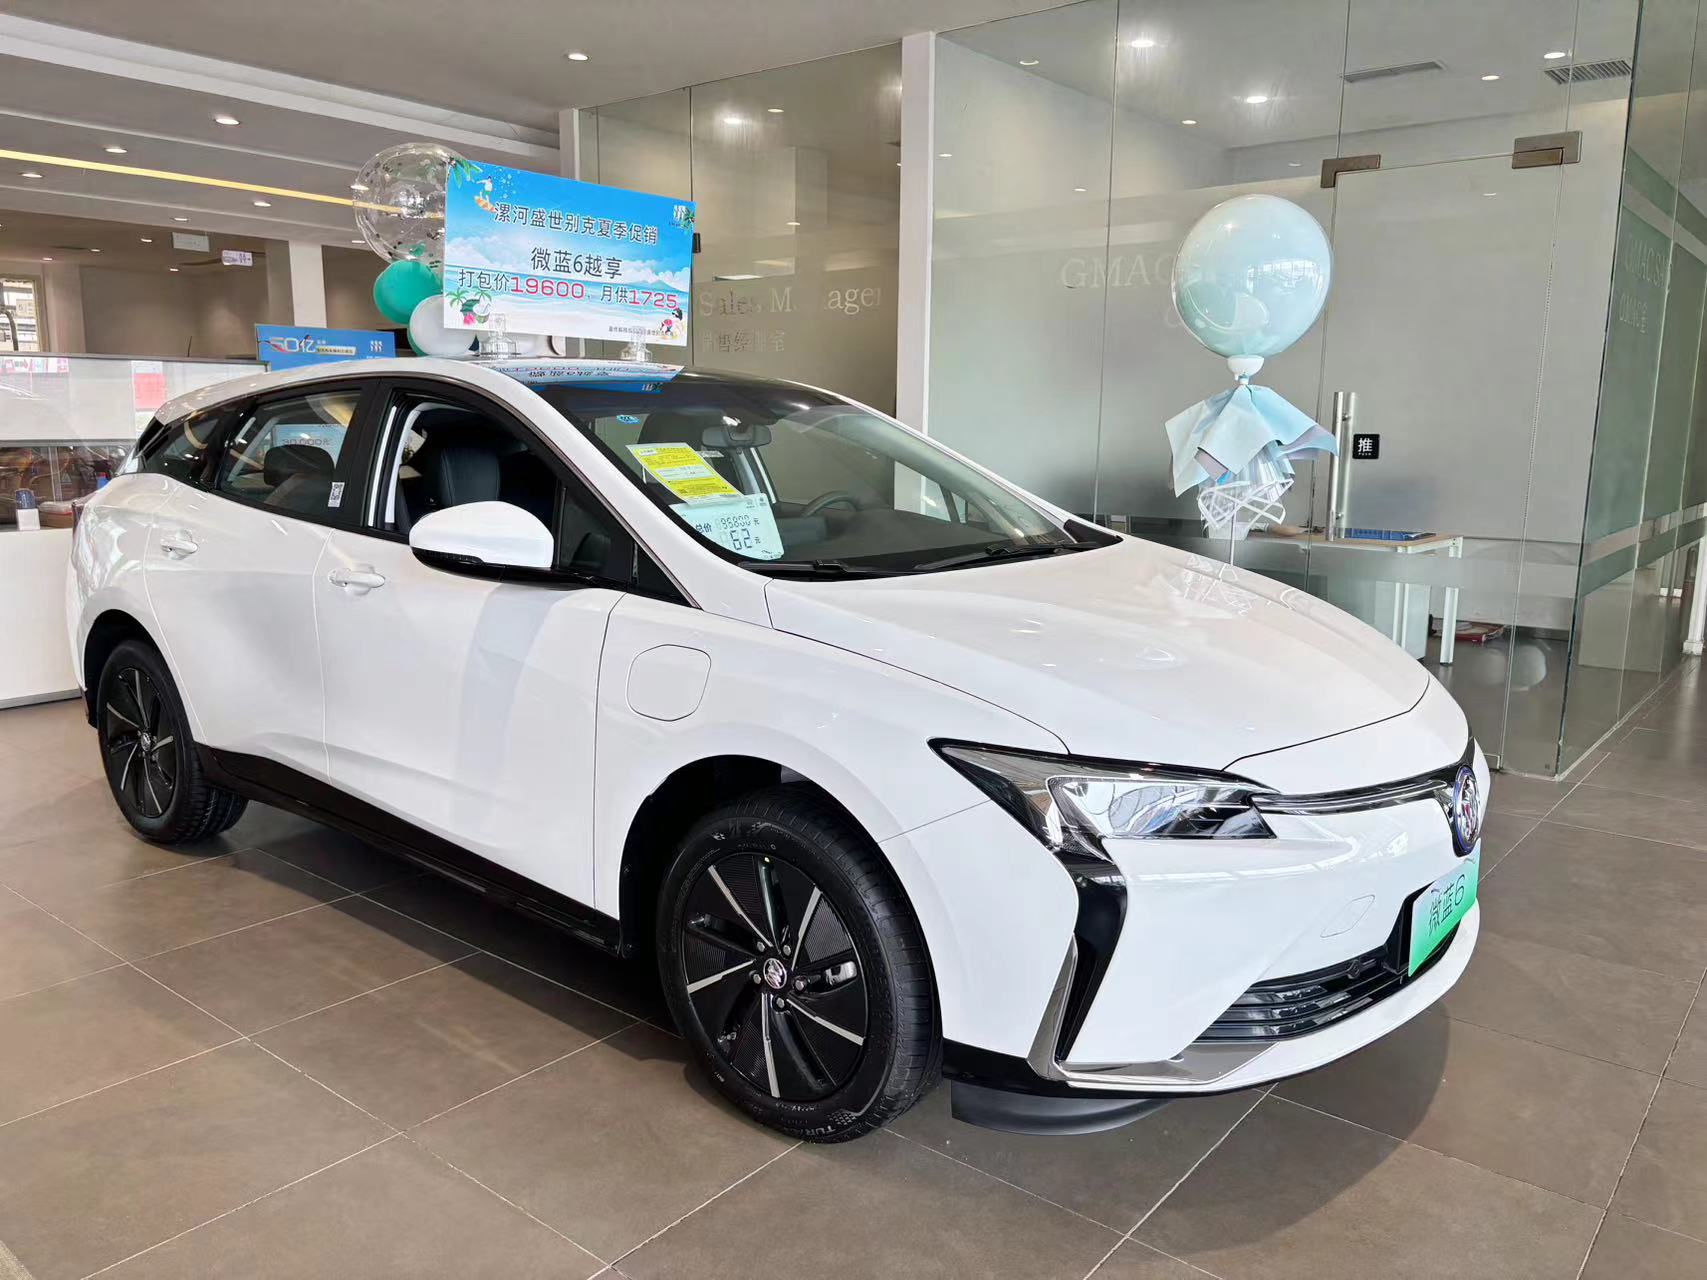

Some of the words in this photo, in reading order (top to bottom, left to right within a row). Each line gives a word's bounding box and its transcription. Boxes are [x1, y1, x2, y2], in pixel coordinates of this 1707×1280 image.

[493, 201, 659, 245] 漯河盛世别克夏季促销
[530, 247, 623, 280] 微蓝6越享
[1358, 437, 1373, 453] 推
[695, 522, 713, 534] 总价
[1428, 873, 1466, 937] 微蓝6
